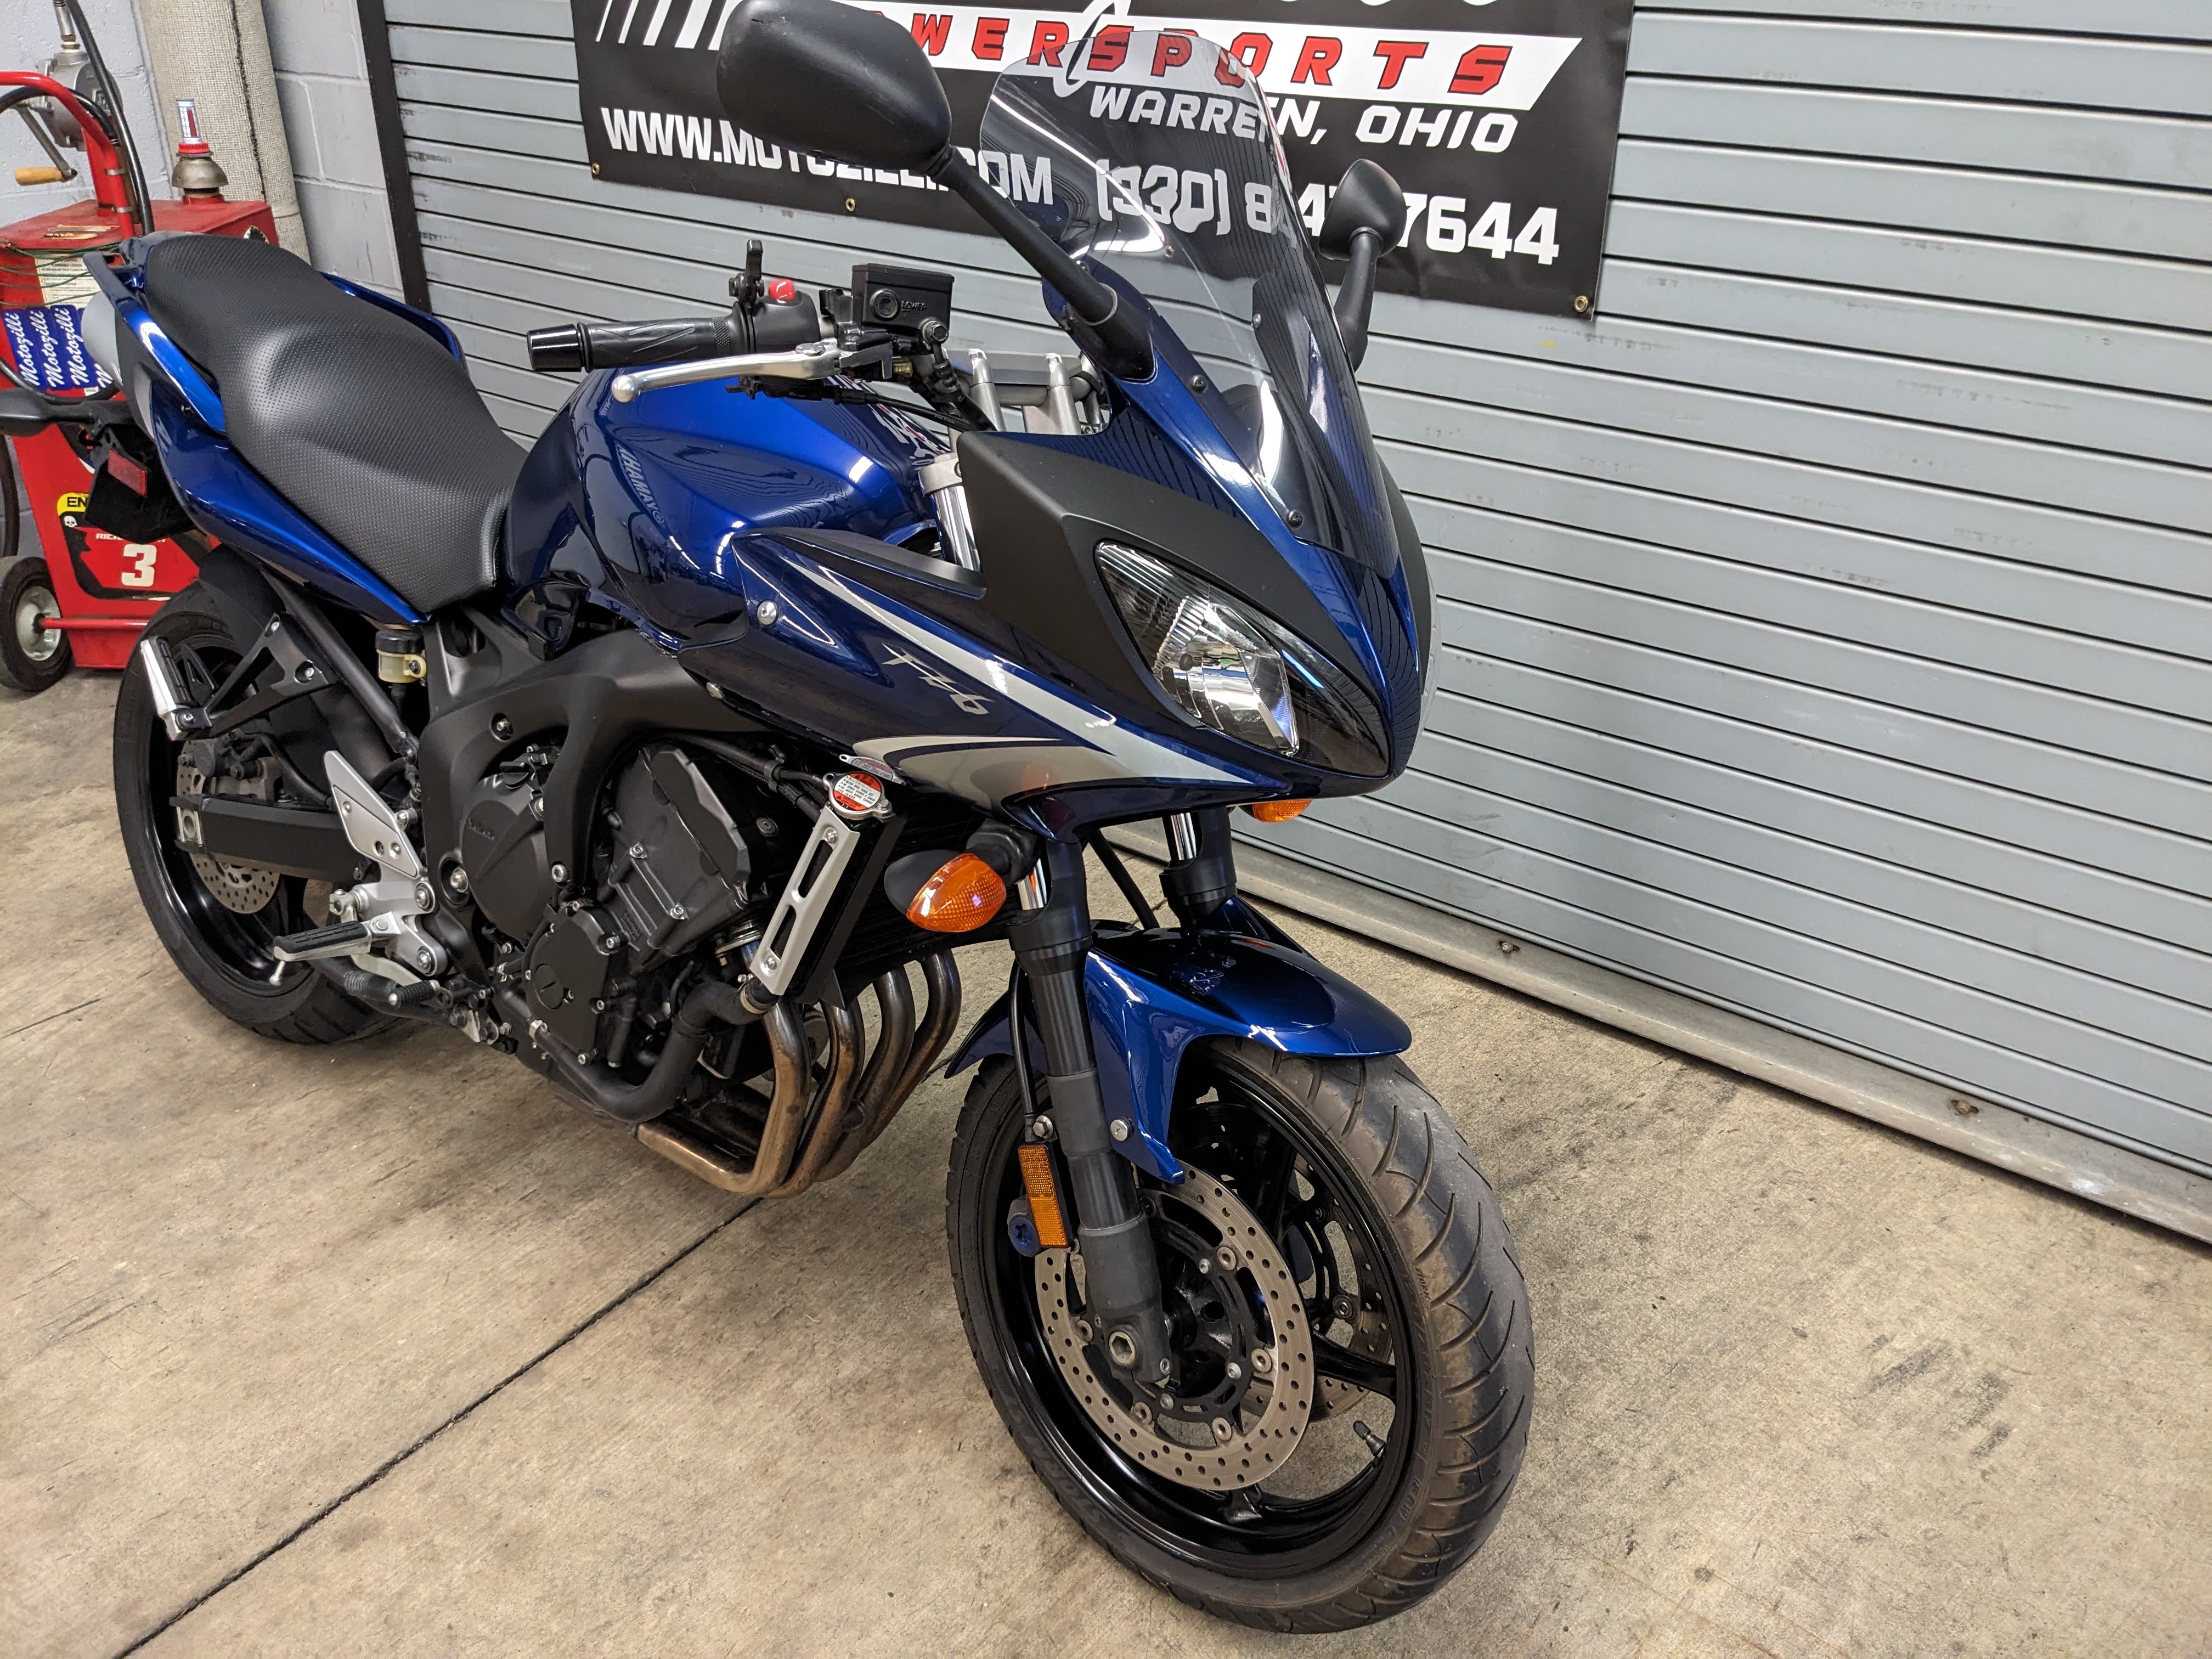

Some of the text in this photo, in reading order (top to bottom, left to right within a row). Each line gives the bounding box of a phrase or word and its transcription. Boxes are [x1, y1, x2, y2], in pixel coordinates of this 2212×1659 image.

[873, 11, 1513, 95] WERSPORTS
[1090, 86, 1519, 153] WARREN, OHIO
[901, 301, 927, 312] LOWER
[4, 312, 41, 386] Motozilli
[29, 310, 65, 387] Motozilli
[54, 307, 90, 386] Motozilli
[121, 543, 157, 587] 3
